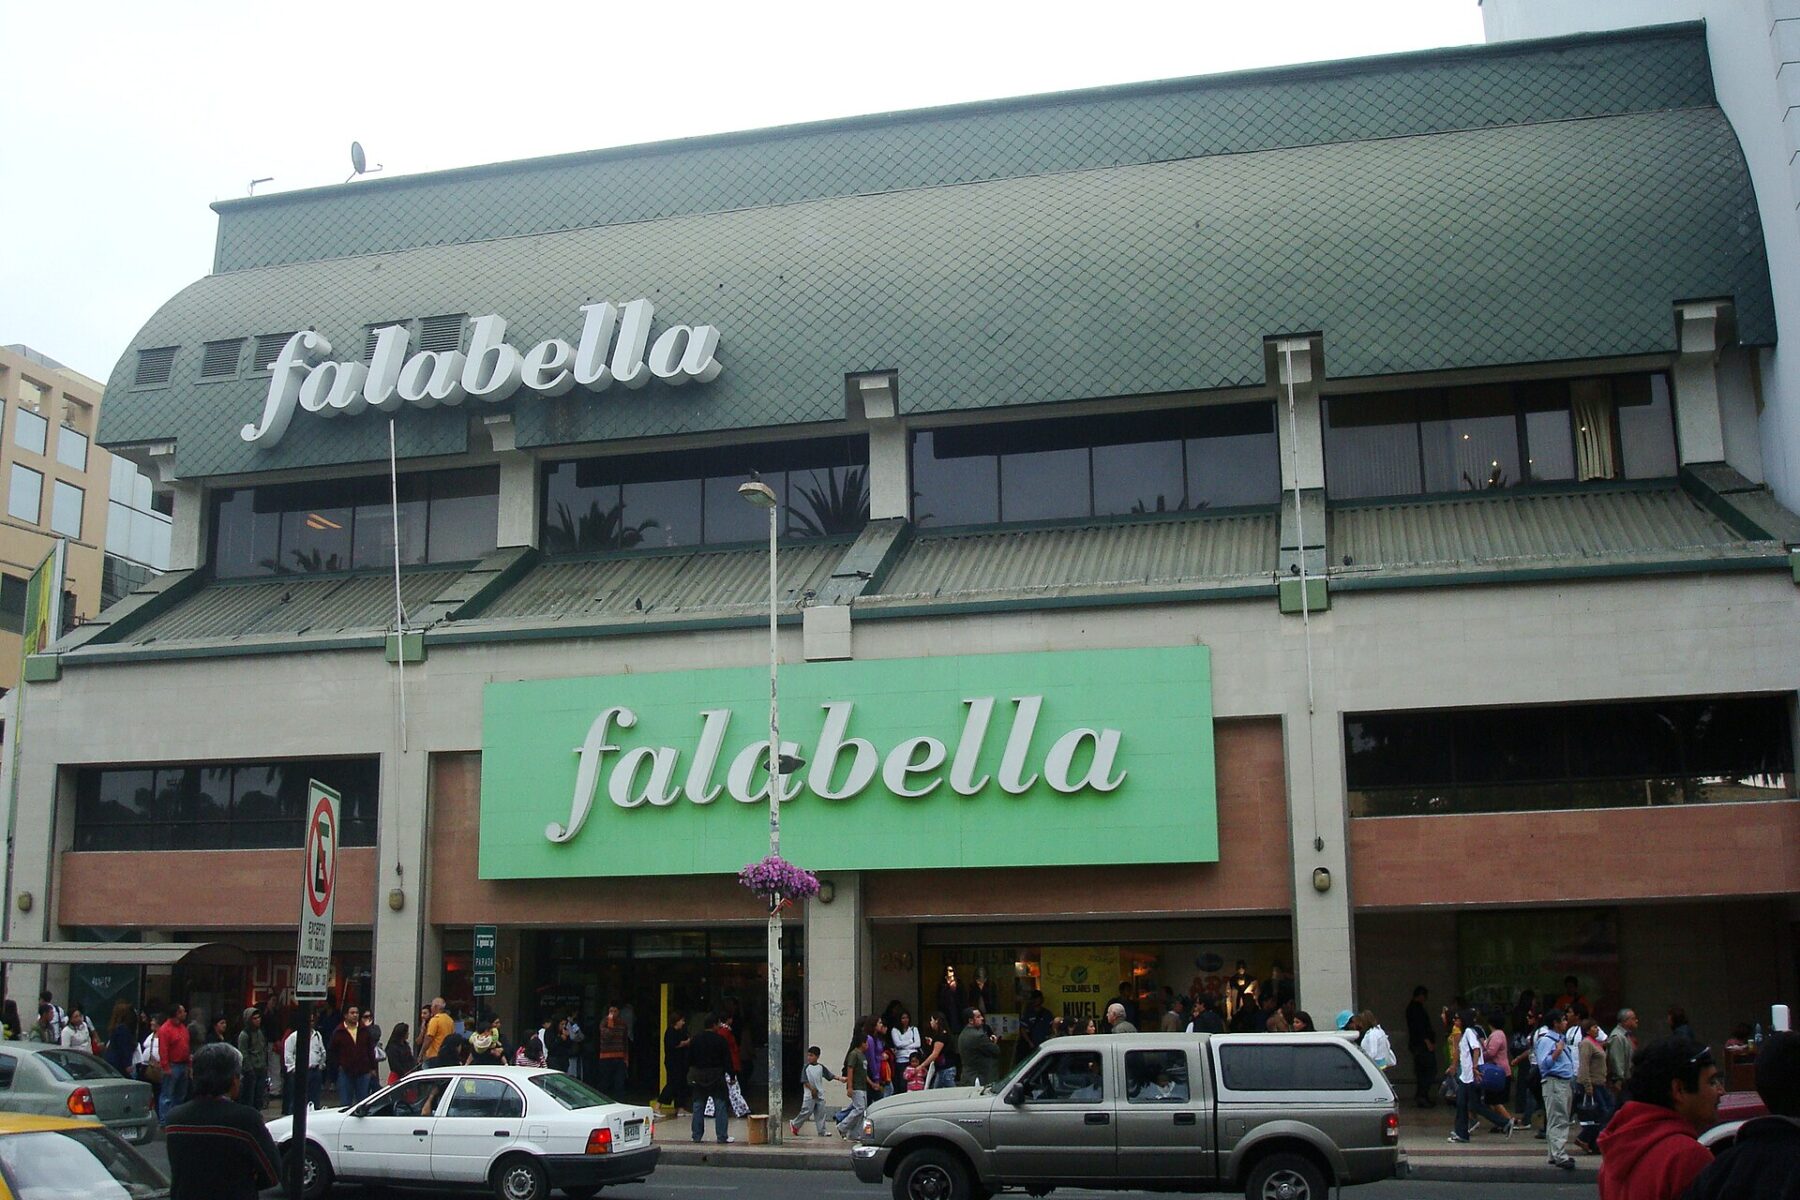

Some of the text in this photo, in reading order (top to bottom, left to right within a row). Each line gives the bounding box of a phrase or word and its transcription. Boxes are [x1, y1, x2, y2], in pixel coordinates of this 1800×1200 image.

[241, 298, 723, 449] falabella
[545, 694, 1128, 843] falabella
[1063, 1001, 1100, 1019] NIVEL
